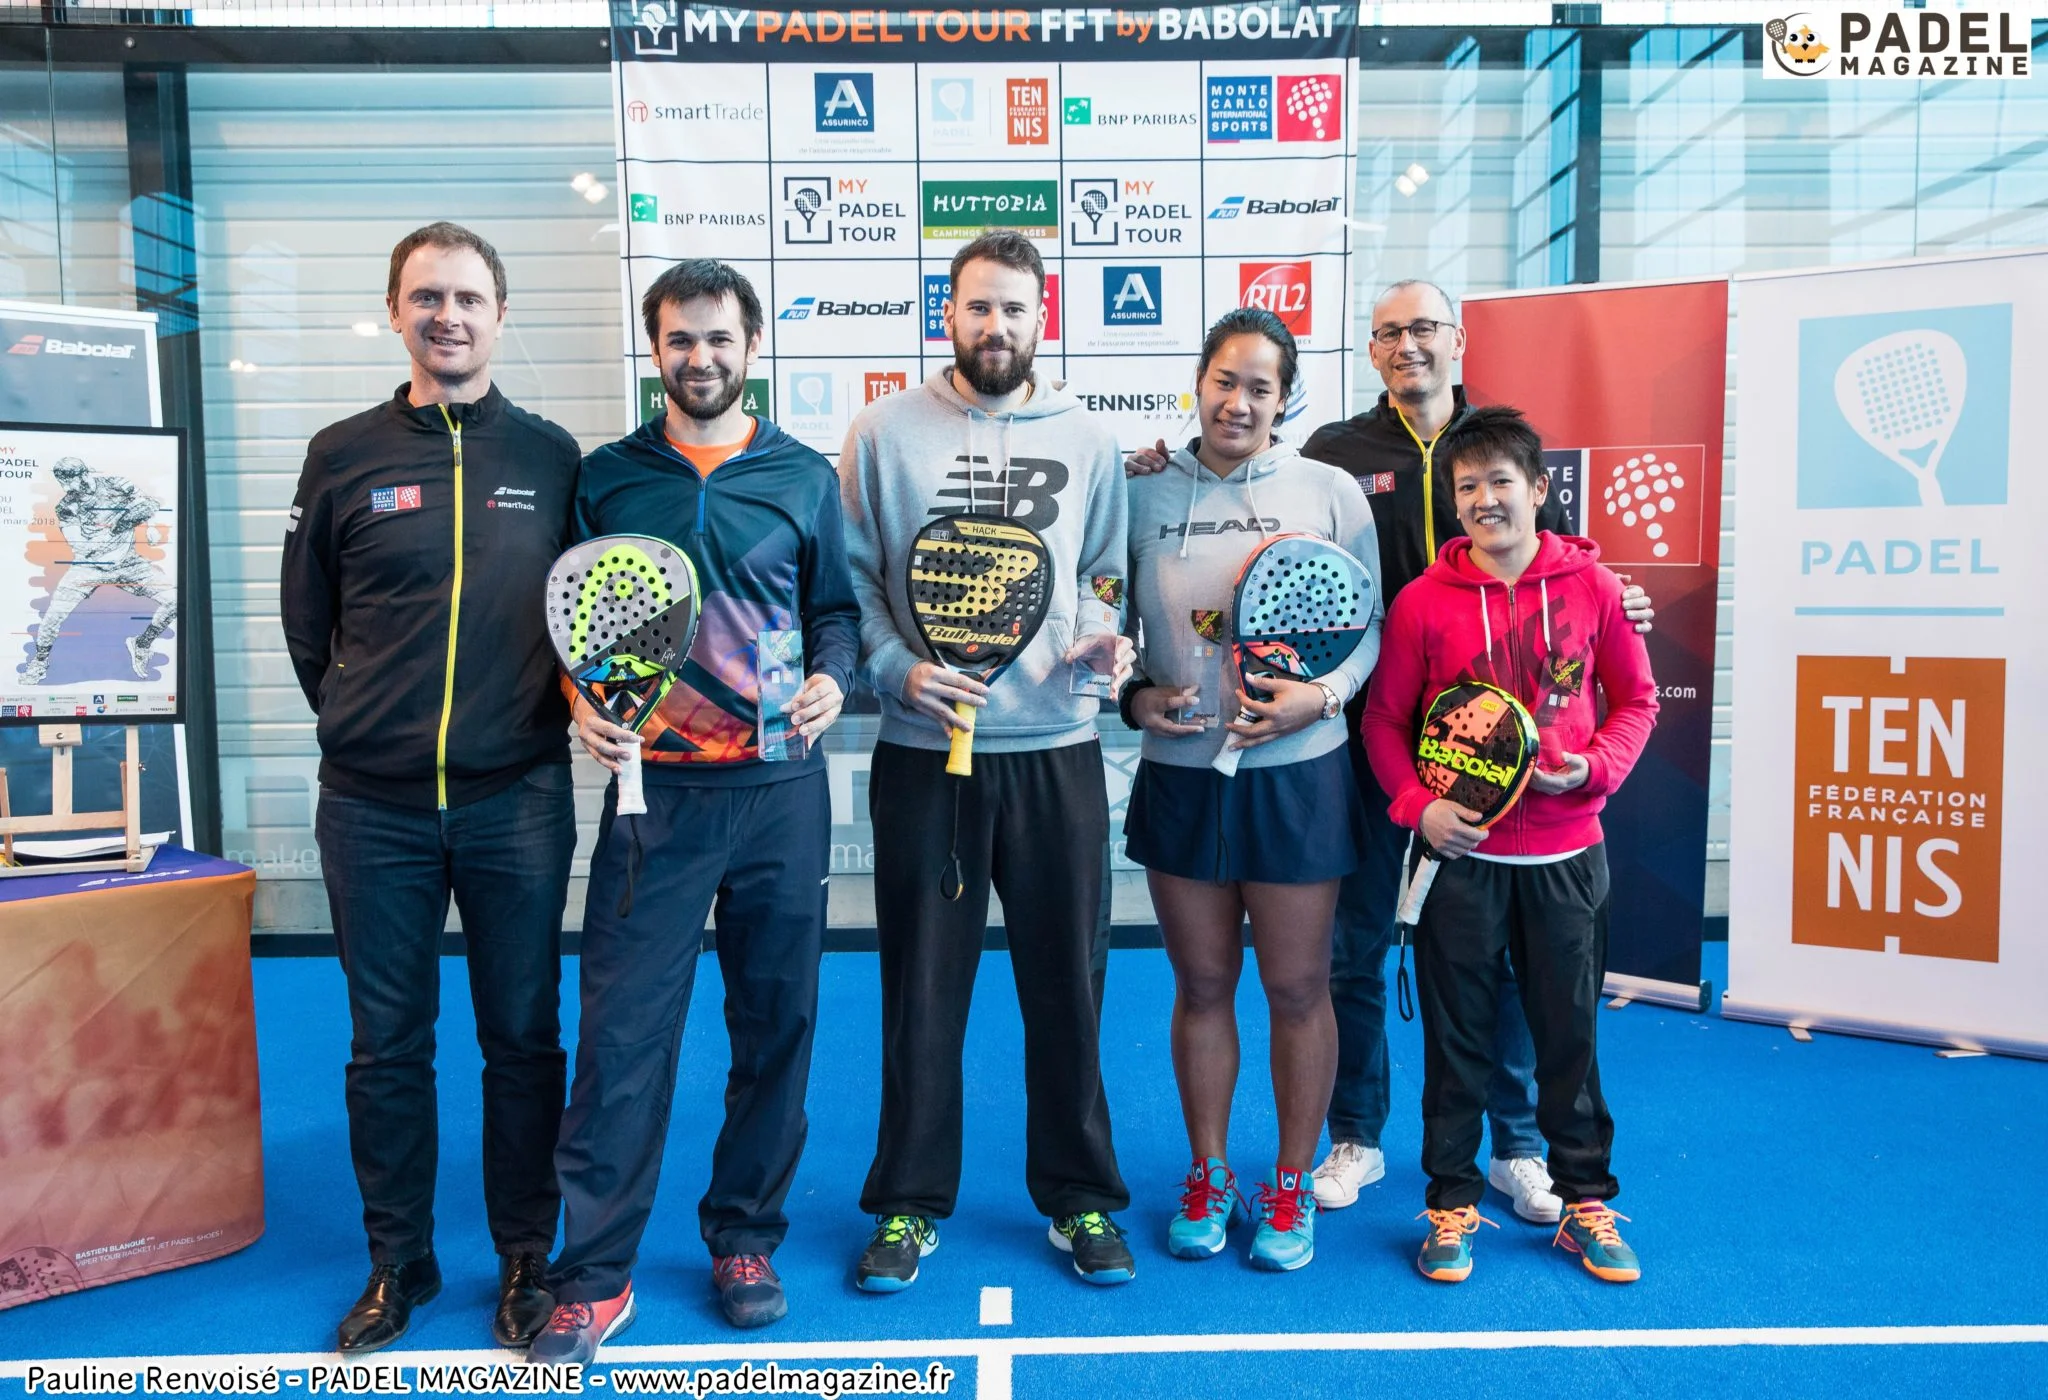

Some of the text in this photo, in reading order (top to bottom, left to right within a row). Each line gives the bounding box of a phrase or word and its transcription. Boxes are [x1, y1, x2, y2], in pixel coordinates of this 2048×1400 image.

[684, 5, 1341, 43] MY PADEL TOUR FFT by BABOLAT
[1012, 86, 1042, 106] TEN
[1211, 84, 1268, 96] MONTE
[655, 102, 764, 121] smartTrade
[1211, 98, 1268, 109] CARLO
[822, 118, 869, 127] ASSURINCO
[1013, 117, 1042, 137] NIS
[1098, 113, 1197, 126] BNP PARIBAS
[1211, 121, 1268, 132] SPORTS
[838, 179, 868, 193] MY
[1125, 181, 1154, 195] MY
[838, 203, 906, 218] PADEL
[933, 193, 1048, 212] HUTTOPIA
[1125, 204, 1193, 219] PADEL
[664, 213, 766, 226] BNP PARIBAS
[838, 227, 896, 242] TOUR
[1125, 228, 1182, 243] TOUR
[1247, 283, 1306, 312] RTL2
[1110, 311, 1157, 320] ASSURINCO
[972, 526, 997, 536] HACK
[1159, 517, 1281, 540] HEAD
[1800, 538, 2000, 575] PADEL
[929, 626, 1023, 646] Bullpadel
[1822, 695, 1966, 778] TEN
[1808, 784, 1987, 809] FÉDÉRATION
[1808, 803, 1986, 829] FRANÇAISE
[1827, 832, 1962, 918] NIS
[75, 1238, 146, 1260] BASTIEN BLANQUÉ
[99, 1252, 121, 1262] TOUR
[121, 1245, 152, 1259] RACKET
[171, 1236, 195, 1247] PADEL
[196, 1230, 220, 1242] SHOES
